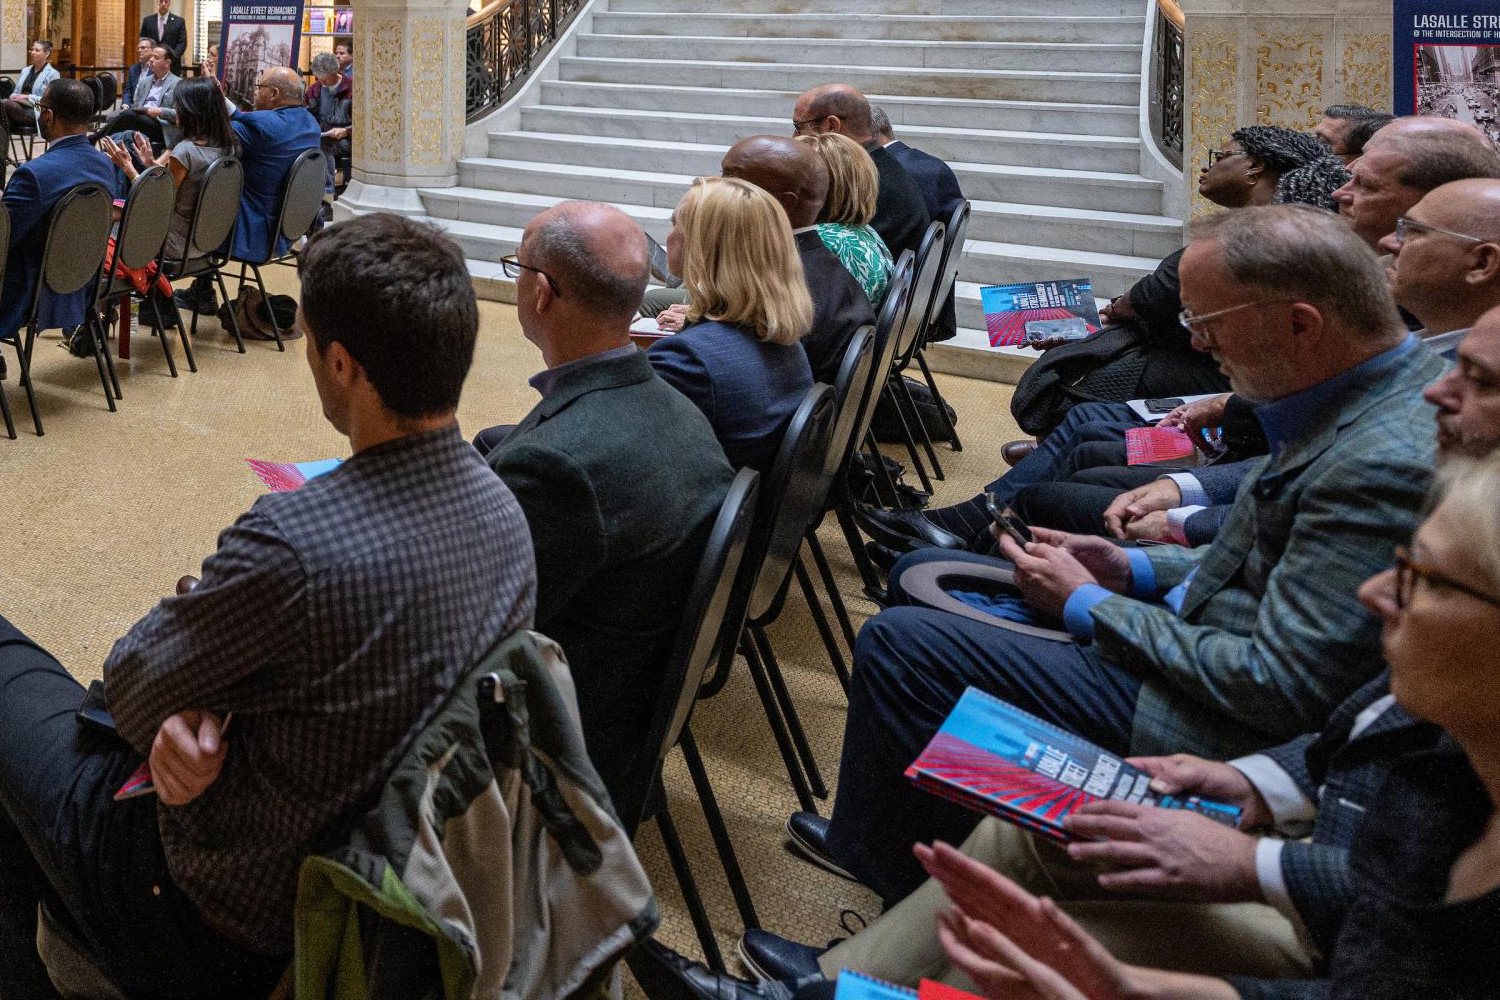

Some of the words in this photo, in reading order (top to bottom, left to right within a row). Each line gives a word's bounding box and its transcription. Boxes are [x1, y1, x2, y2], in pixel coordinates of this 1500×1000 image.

[250, 6, 267, 14] STREET
[1414, 15, 1468, 28] LASALLE
[1473, 15, 1500, 29] STR
[1422, 29, 1433, 37] THE
[1436, 30, 1481, 38] INTERSECTION
